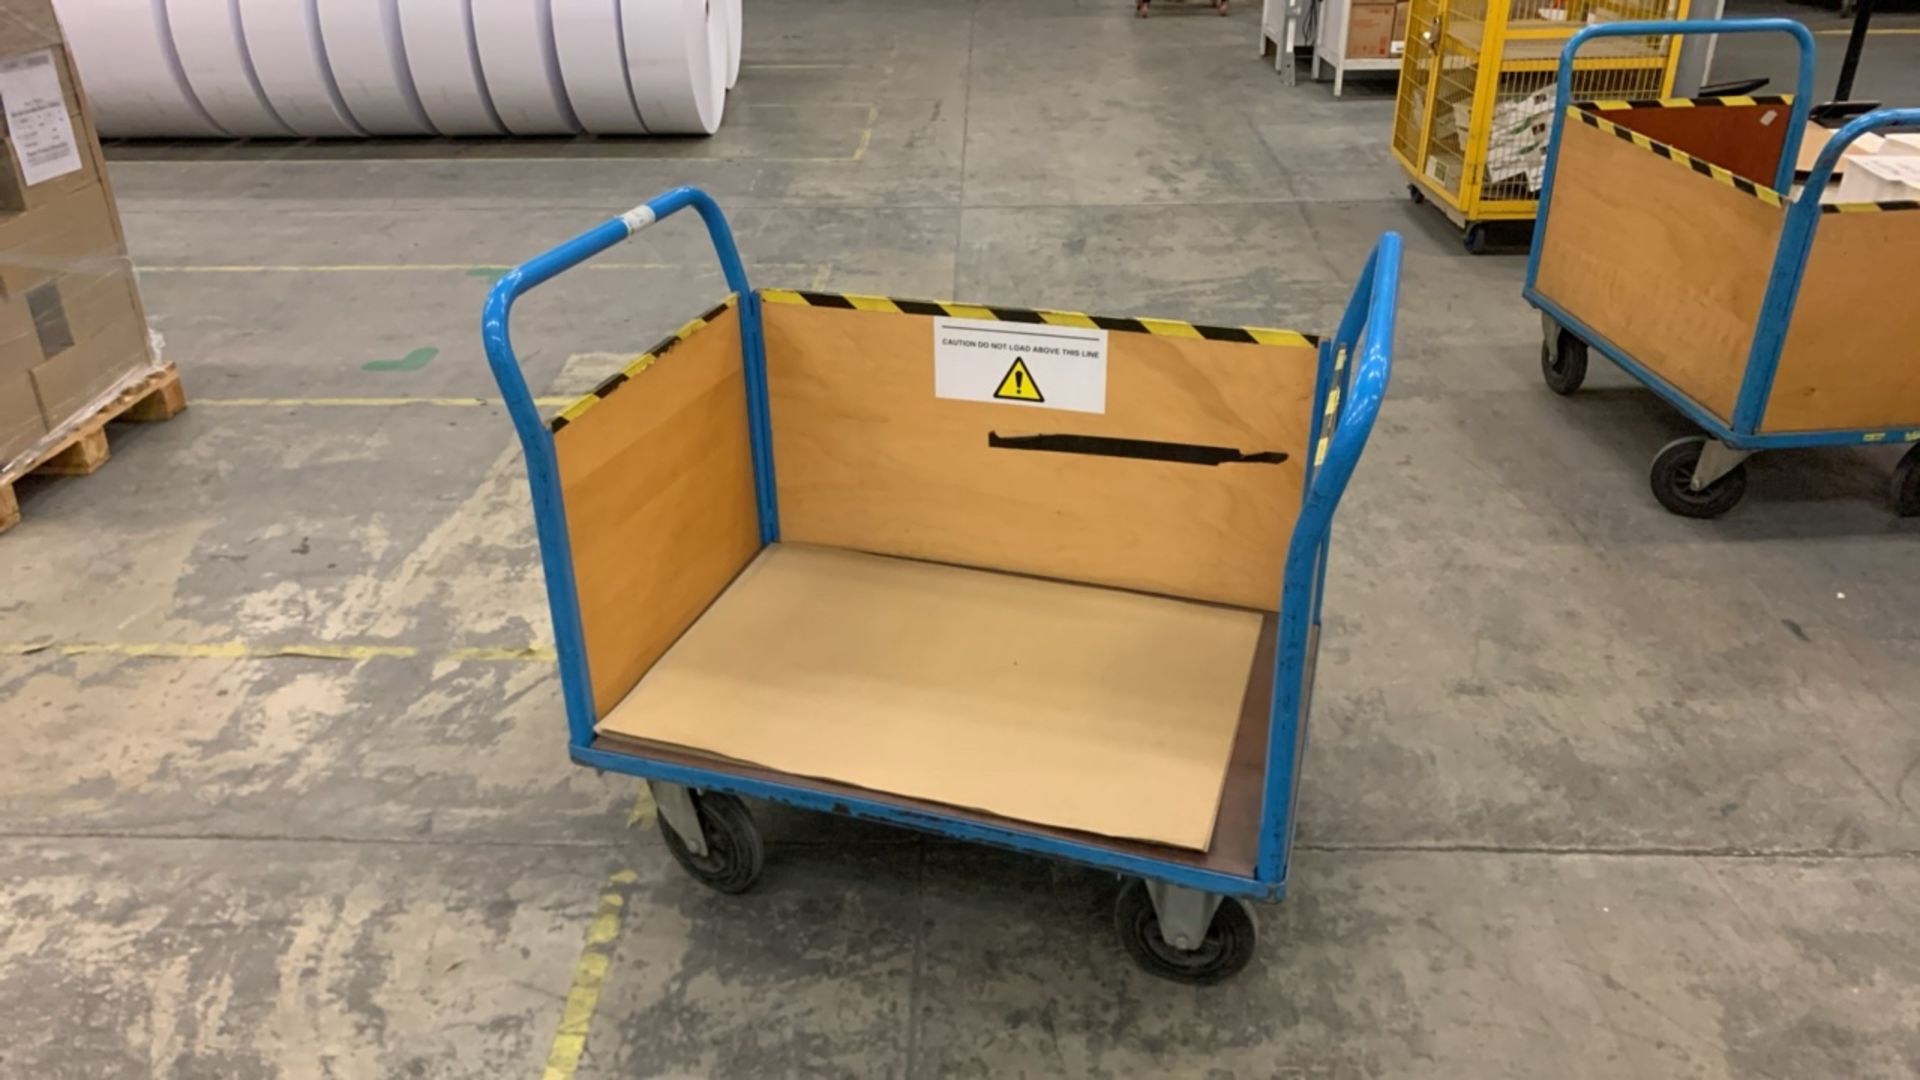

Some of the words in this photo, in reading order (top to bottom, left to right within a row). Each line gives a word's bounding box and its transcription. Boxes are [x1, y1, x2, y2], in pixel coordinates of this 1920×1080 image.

[942, 338, 976, 348] CAUTION
[977, 341, 990, 349] DO
[991, 342, 1007, 350] NOT
[1009, 344, 1031, 353] LOAD
[1033, 345, 1060, 356] ABOVE
[1062, 348, 1080, 357] THIS
[1081, 350, 1099, 359] LINE
